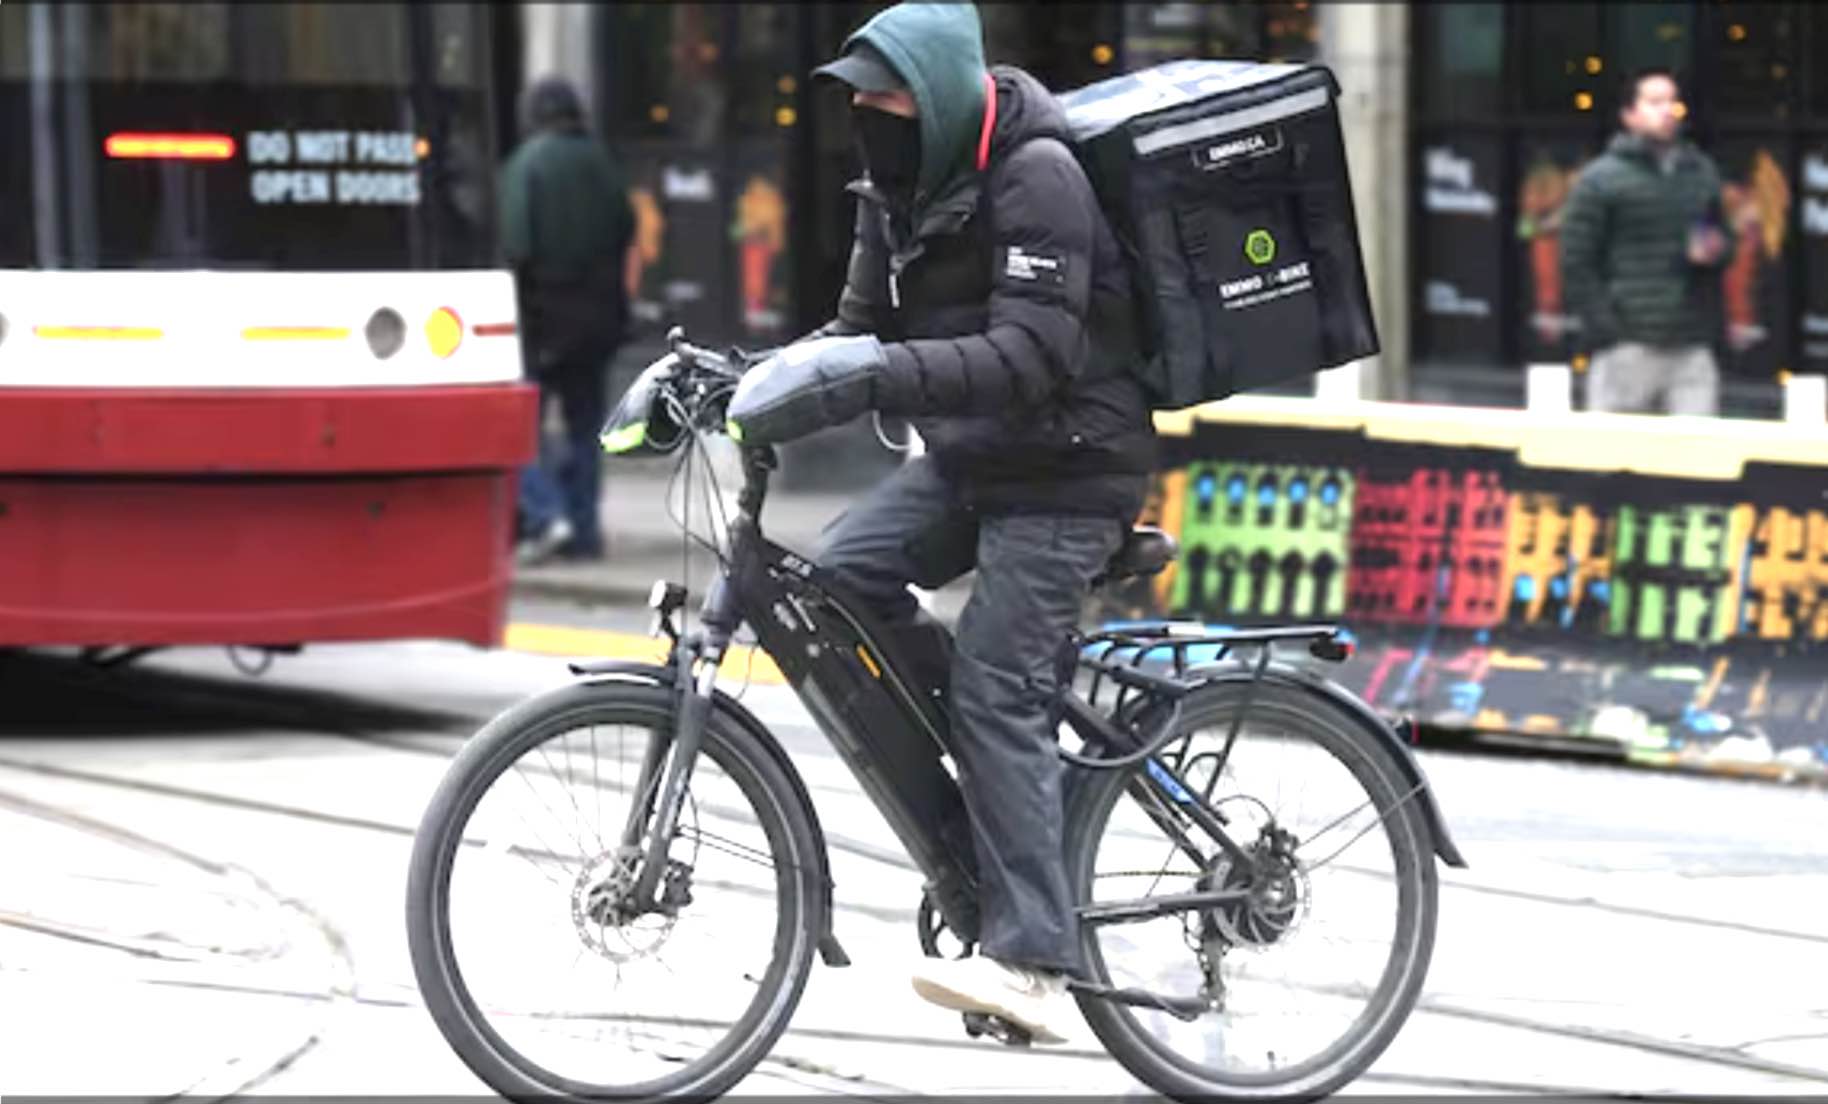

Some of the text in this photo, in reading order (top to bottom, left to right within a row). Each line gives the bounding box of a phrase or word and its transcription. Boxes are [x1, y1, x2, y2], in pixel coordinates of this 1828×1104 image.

[248, 130, 415, 164] DO NOT PASS
[252, 170, 420, 205] OPEN DOORS
[1220, 275, 1263, 298] EMMO
